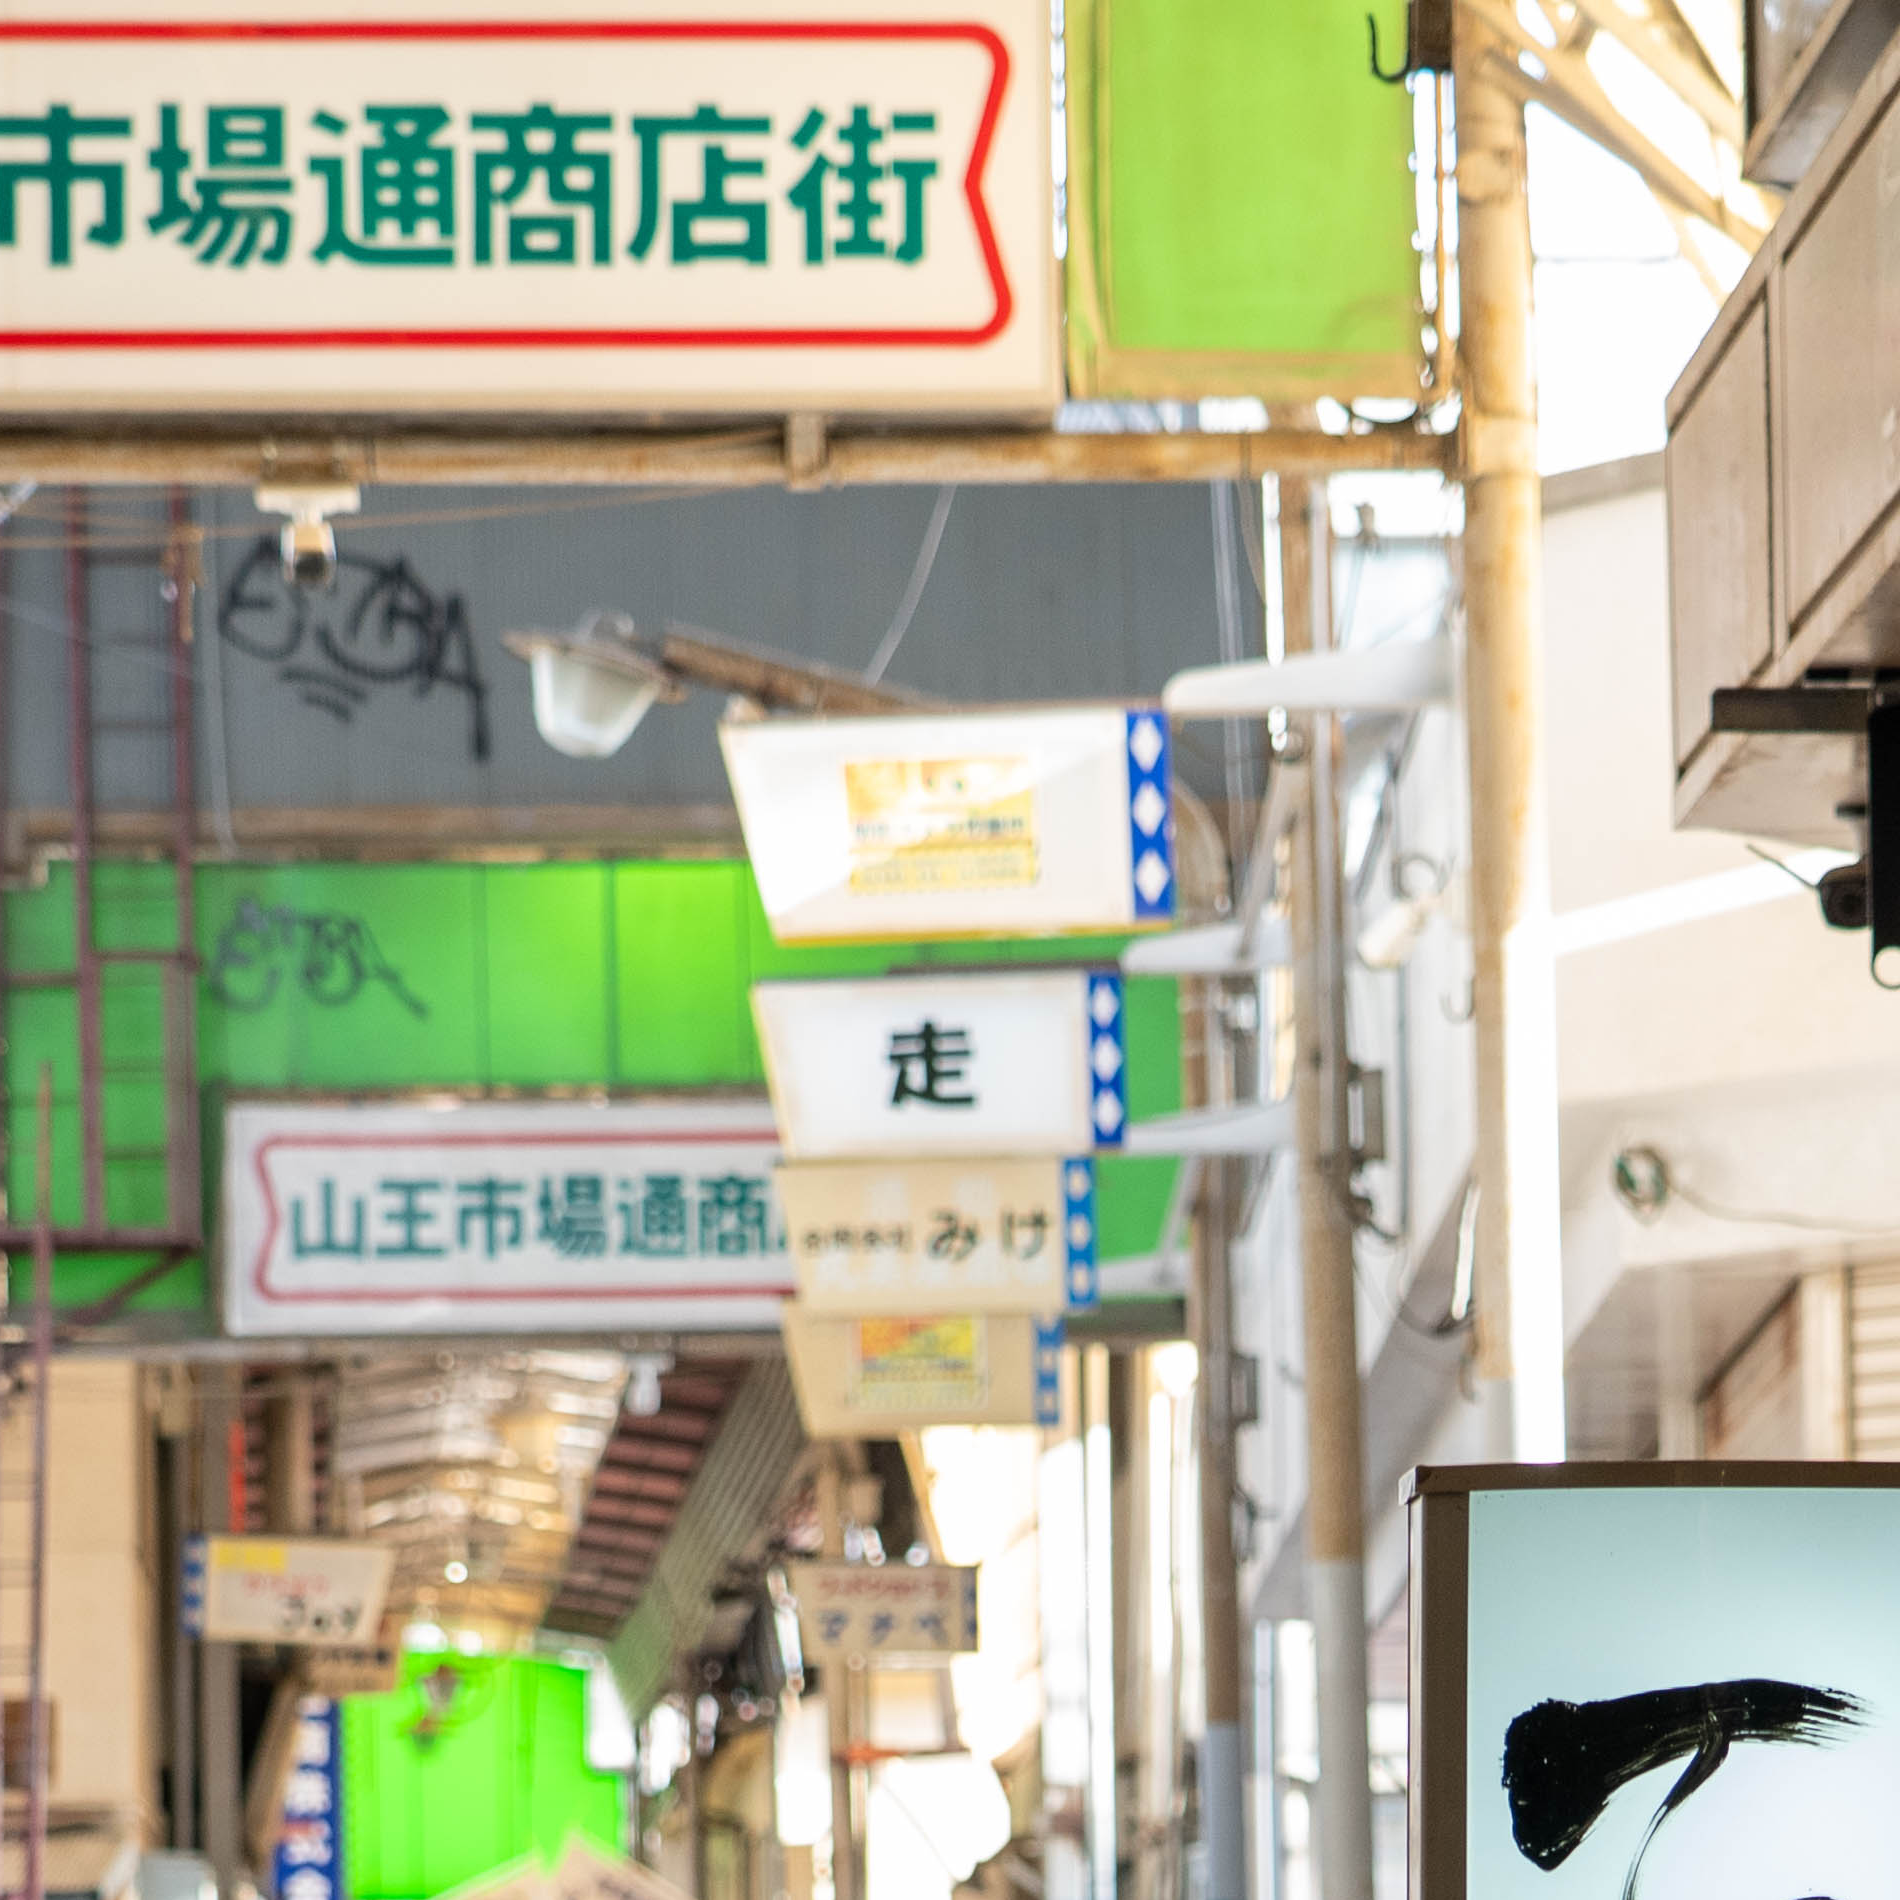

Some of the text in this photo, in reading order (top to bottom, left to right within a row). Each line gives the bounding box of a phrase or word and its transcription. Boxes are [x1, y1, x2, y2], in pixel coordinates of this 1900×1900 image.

[887, 1020, 976, 1110] 走
[290, 1171, 788, 1263] 山王市場通商
